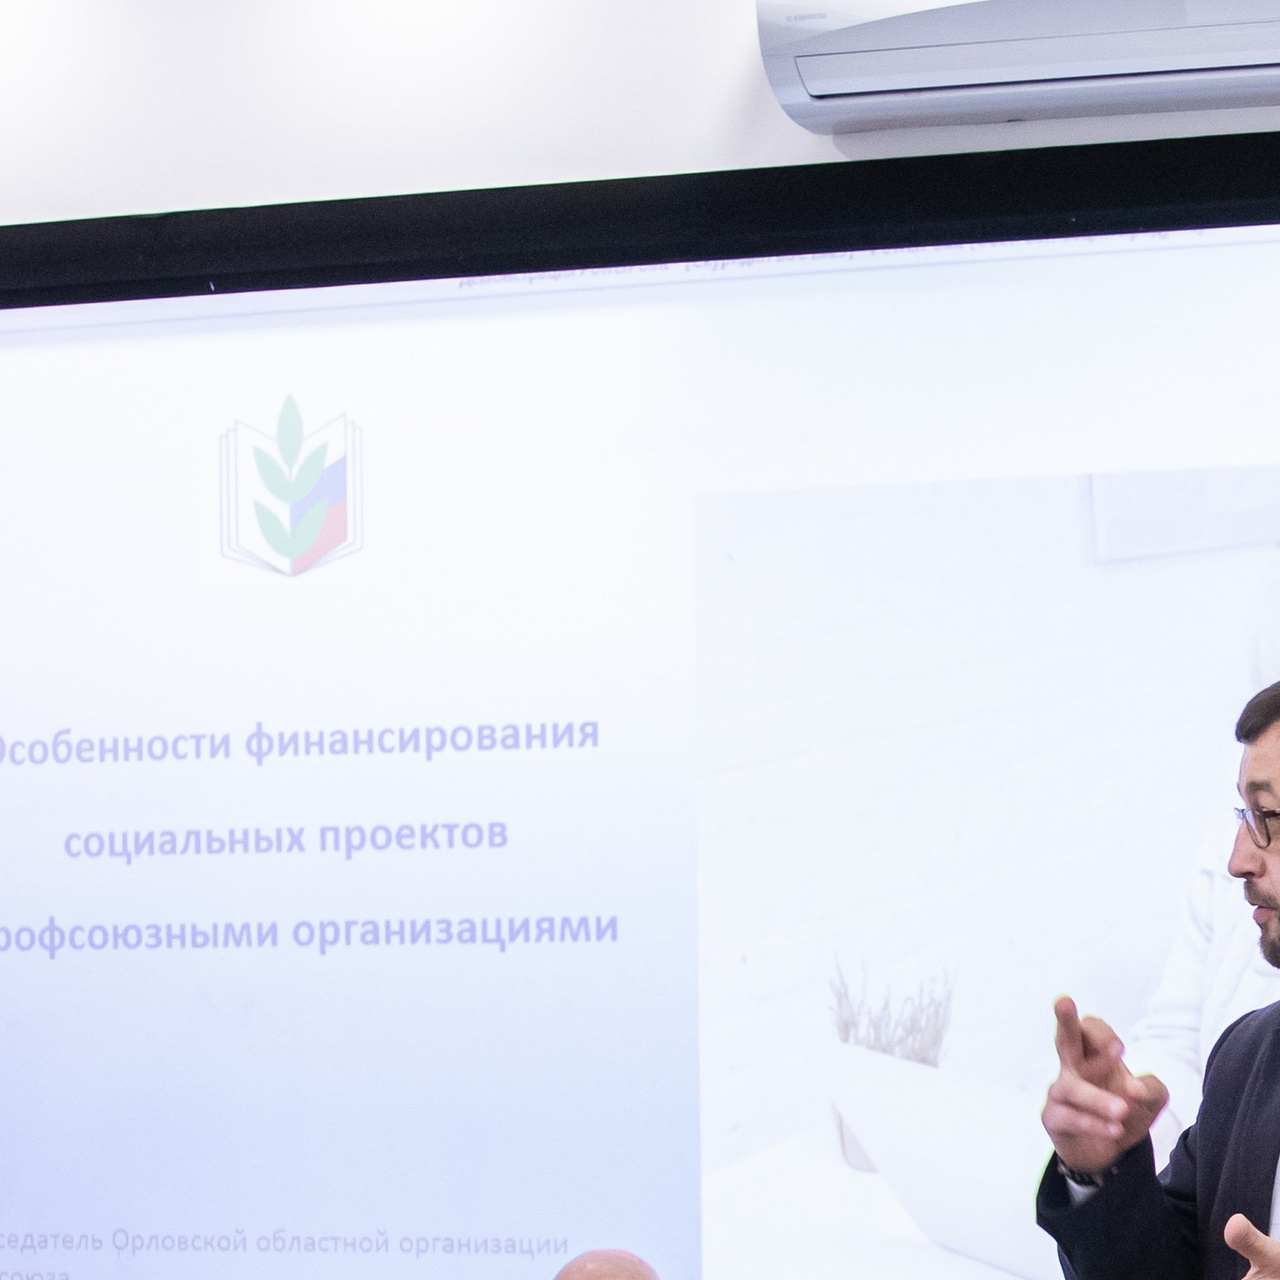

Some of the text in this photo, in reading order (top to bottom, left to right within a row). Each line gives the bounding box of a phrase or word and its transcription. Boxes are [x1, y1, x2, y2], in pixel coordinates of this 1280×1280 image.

[244, 721, 600, 767] финансирования
[63, 821, 509, 865] социальных проектов
[292, 915, 619, 956] организациями
[111, 1229, 248, 1256] Орловской
[255, 1229, 390, 1254] областной
[398, 1234, 569, 1258] организации
